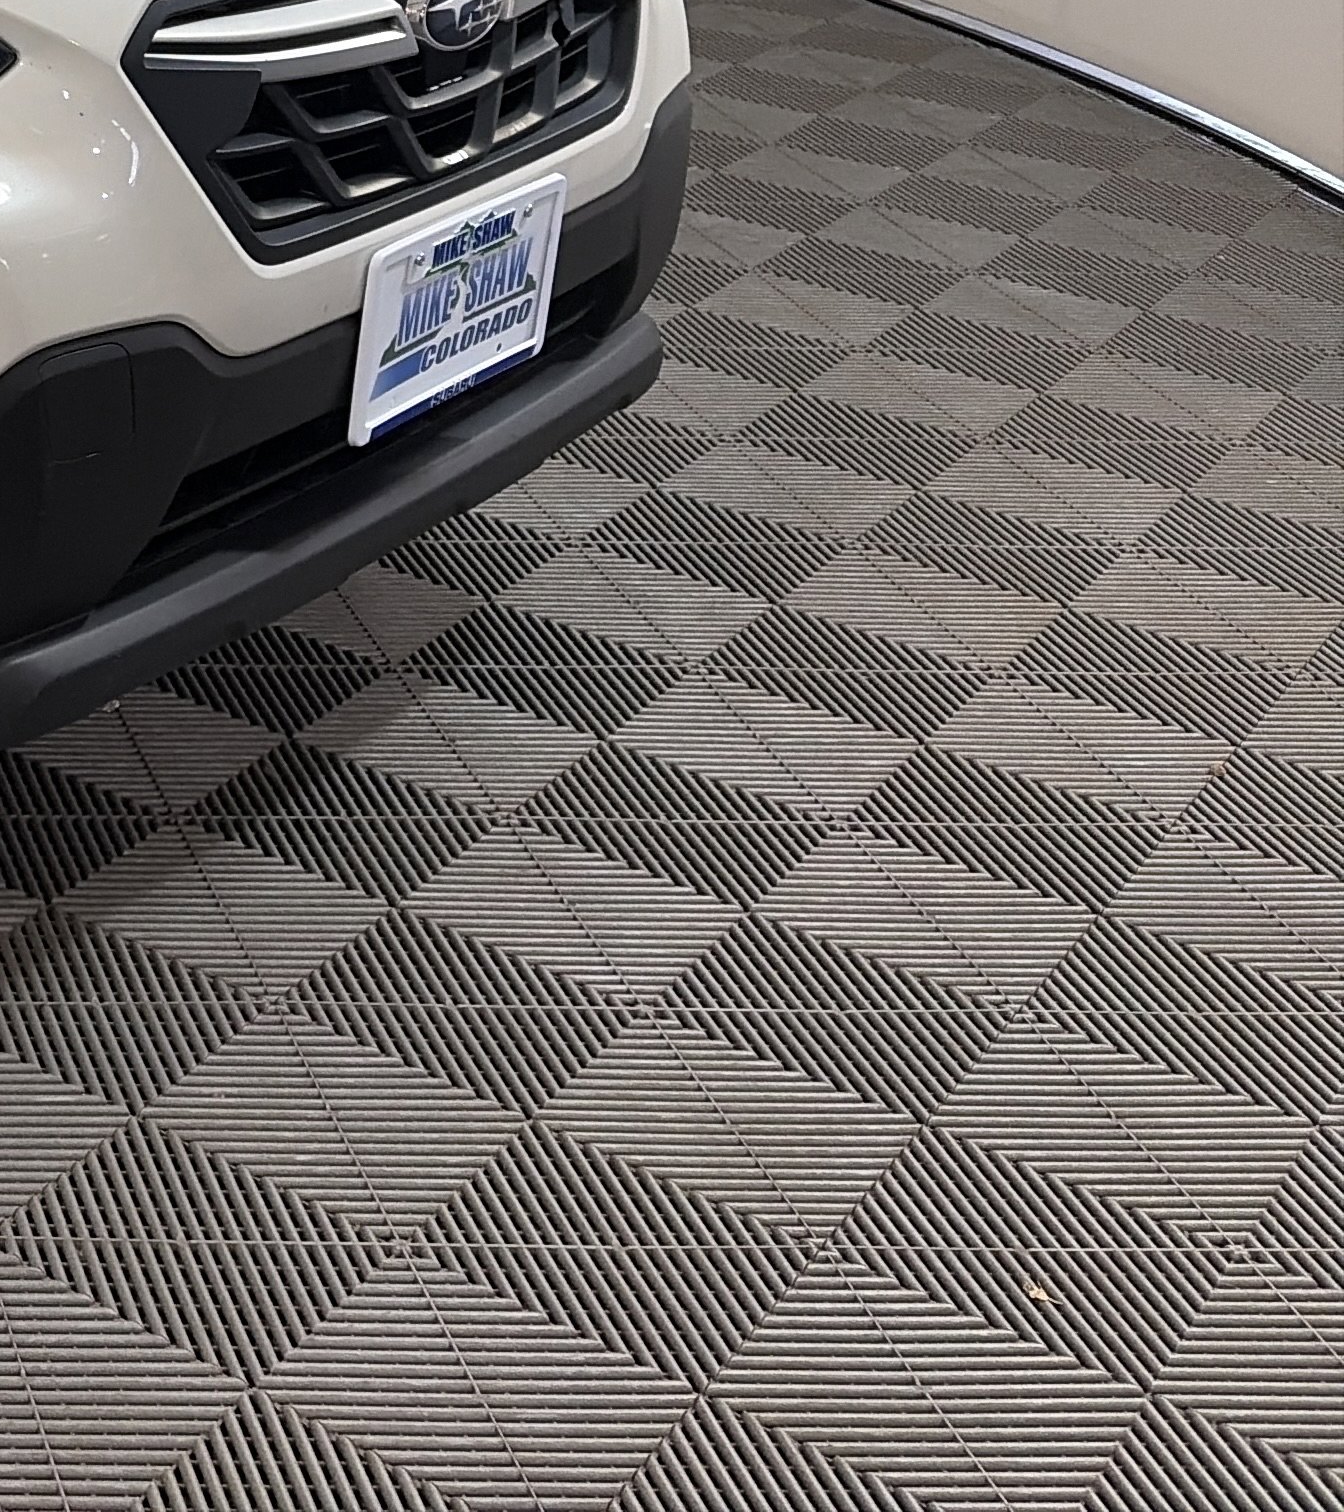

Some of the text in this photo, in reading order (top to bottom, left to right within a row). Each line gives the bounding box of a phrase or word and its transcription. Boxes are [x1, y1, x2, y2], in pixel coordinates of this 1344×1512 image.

[431, 210, 516, 268] MIKE SHAW
[397, 238, 533, 347] MIKE SHAW
[420, 298, 533, 372] COLORADO
